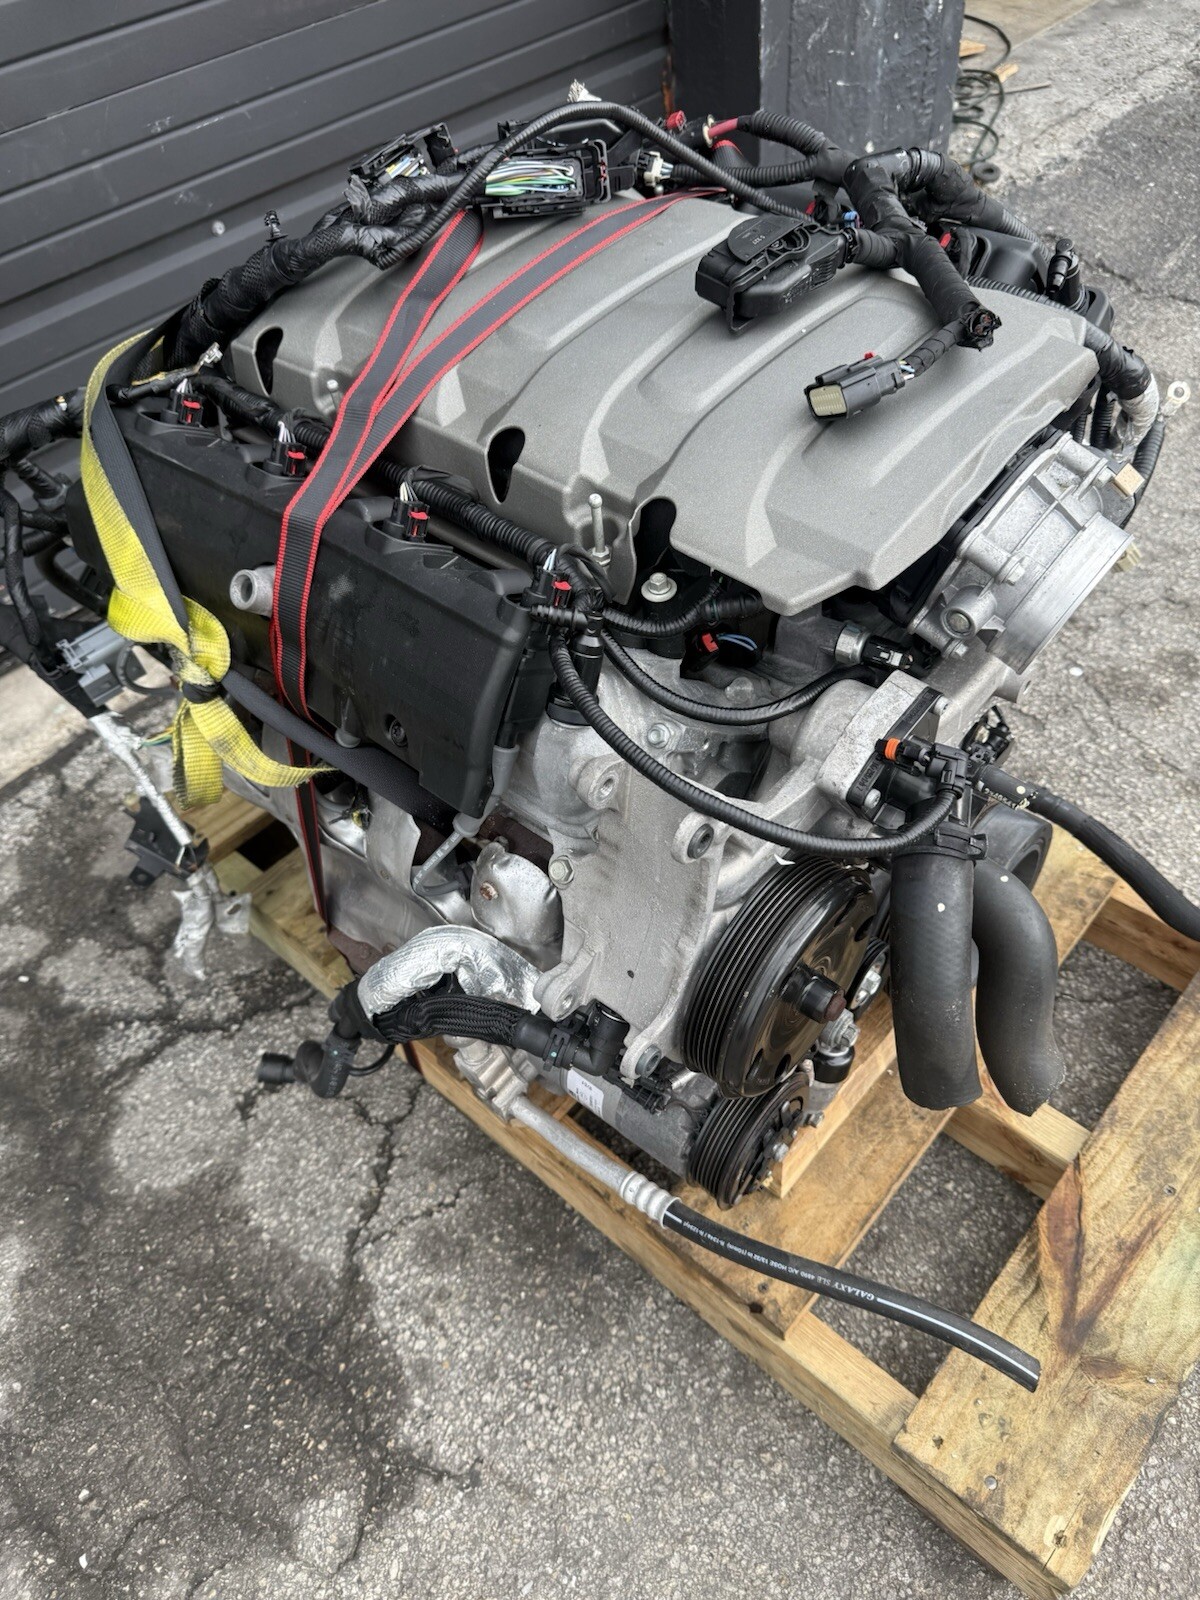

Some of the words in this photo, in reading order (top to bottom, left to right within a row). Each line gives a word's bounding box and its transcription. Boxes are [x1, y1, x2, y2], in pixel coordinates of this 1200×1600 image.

[707, 1233, 725, 1246] R-134a
[726, 1242, 747, 1255] (10mm)
[769, 1259, 787, 1271] HOSE
[787, 1266, 800, 1275] A/C
[831, 1281, 875, 1301] GALAXY
